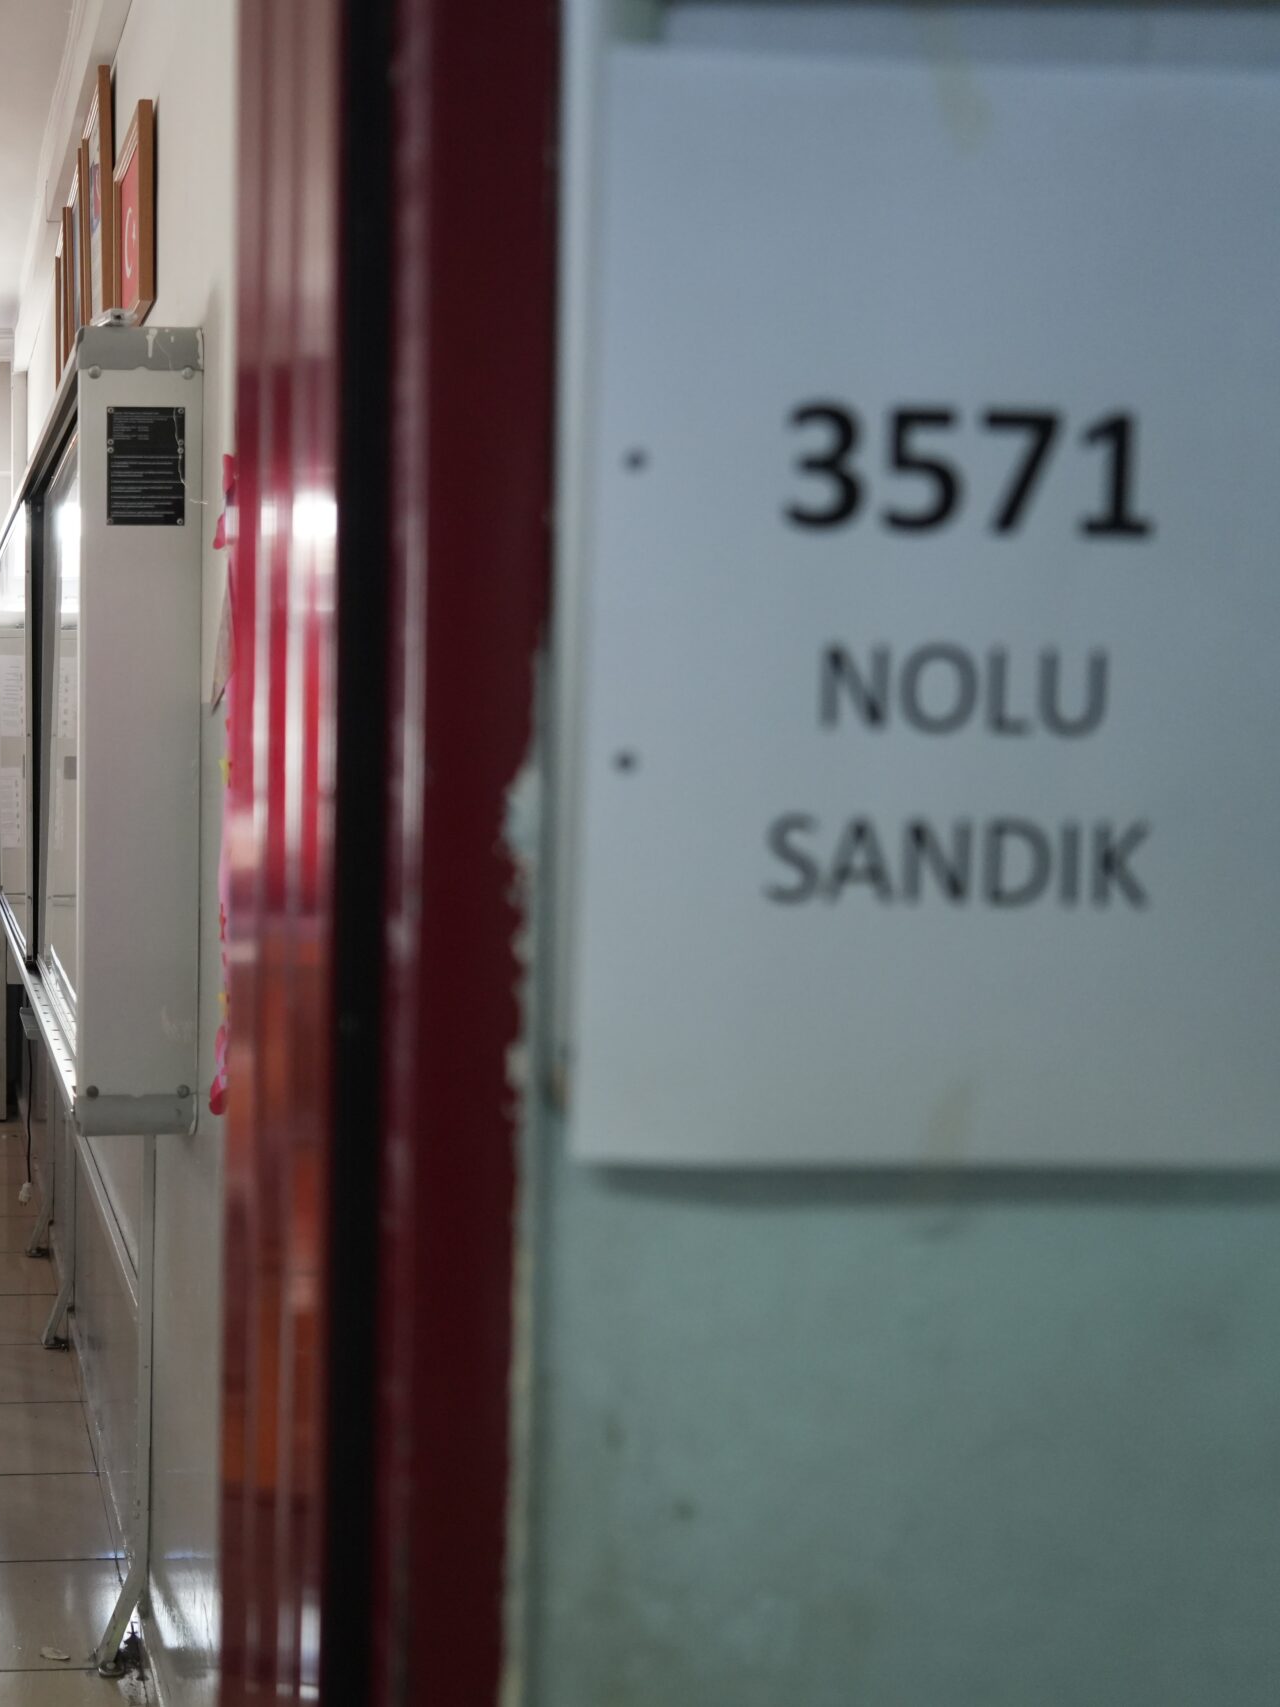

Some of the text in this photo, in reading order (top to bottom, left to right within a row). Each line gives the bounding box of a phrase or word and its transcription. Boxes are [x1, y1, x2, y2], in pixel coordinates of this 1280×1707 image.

[782, 398, 1156, 541] 3571
[819, 641, 1109, 738] NOLU
[765, 814, 1150, 909] SANDIK
